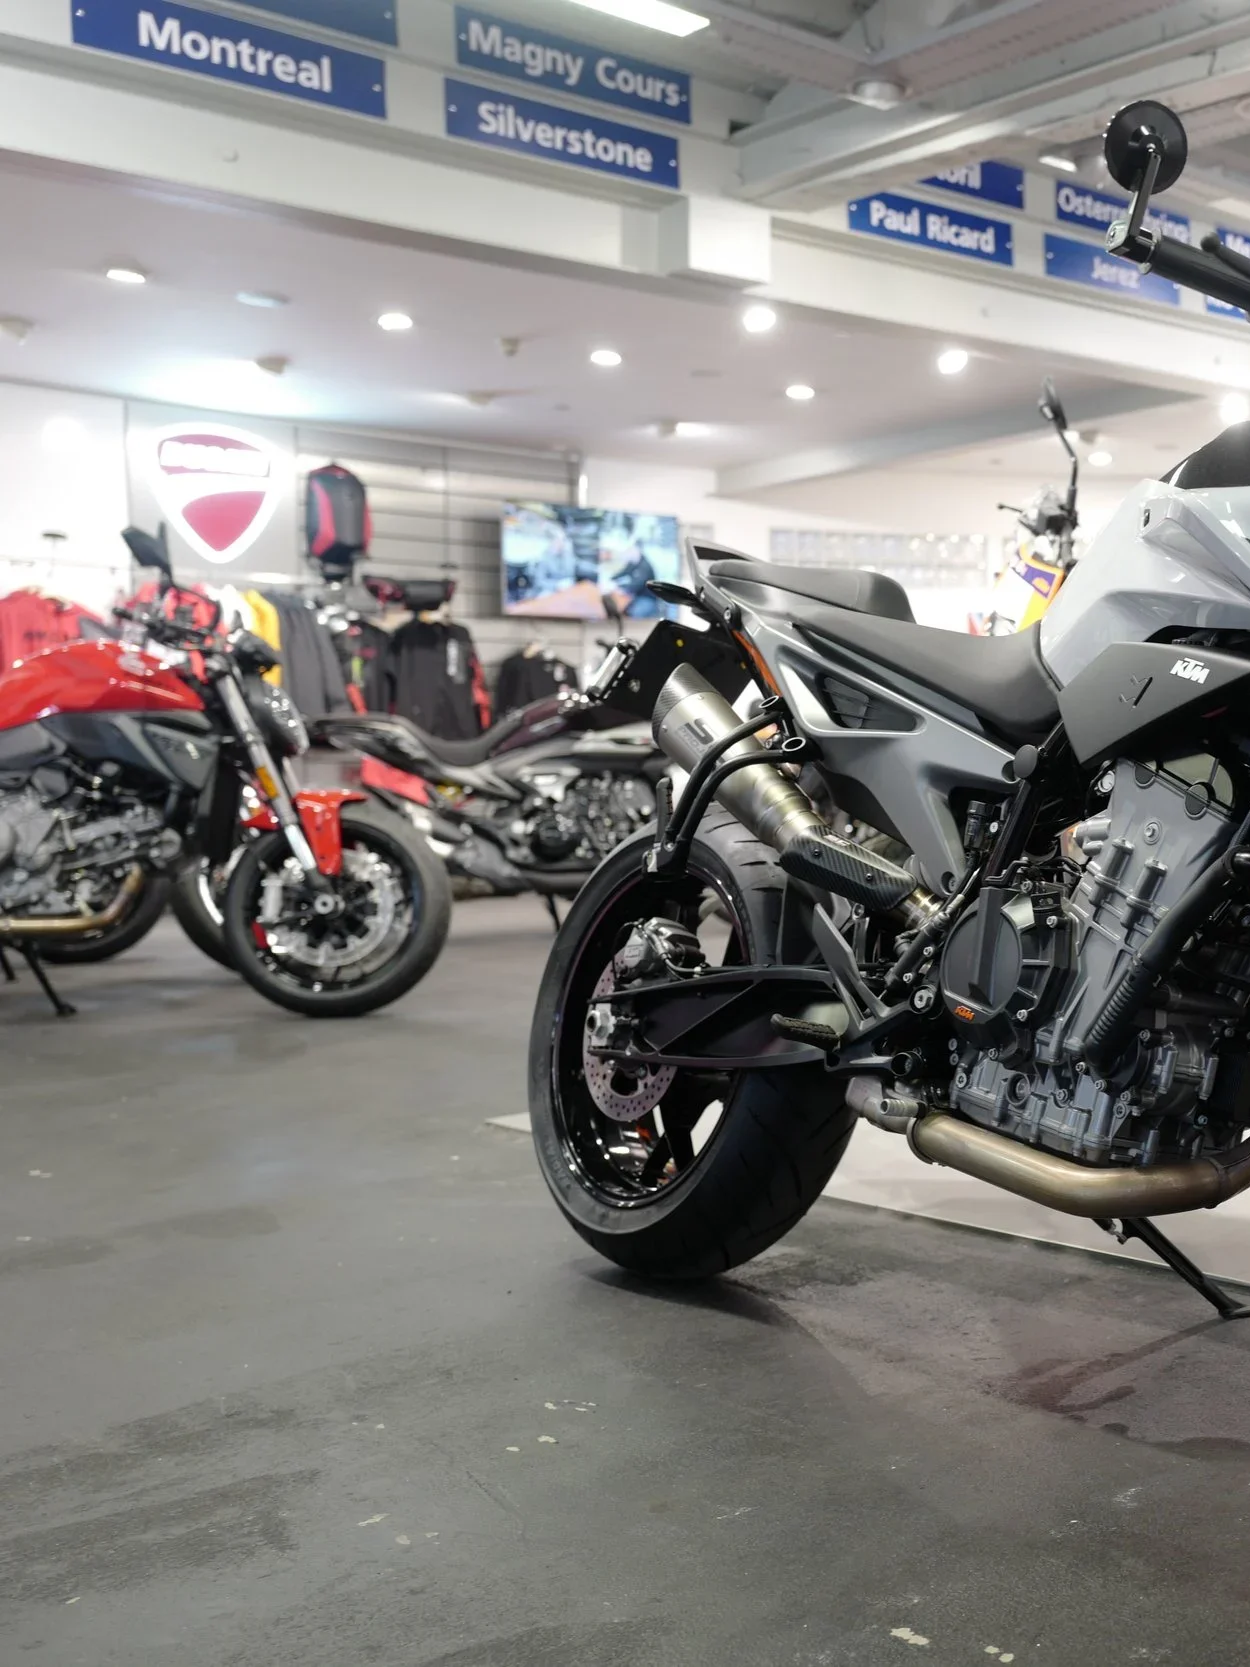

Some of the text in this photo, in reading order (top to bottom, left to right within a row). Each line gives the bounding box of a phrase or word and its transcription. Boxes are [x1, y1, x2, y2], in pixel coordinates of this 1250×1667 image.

[137, 10, 332, 93] Montreal
[468, 19, 681, 107] Magny Cours
[478, 100, 653, 173] Silverstone
[869, 200, 996, 254] Paul Ricard
[1169, 657, 1210, 684] KTM
[954, 1004, 976, 1021] KTM
